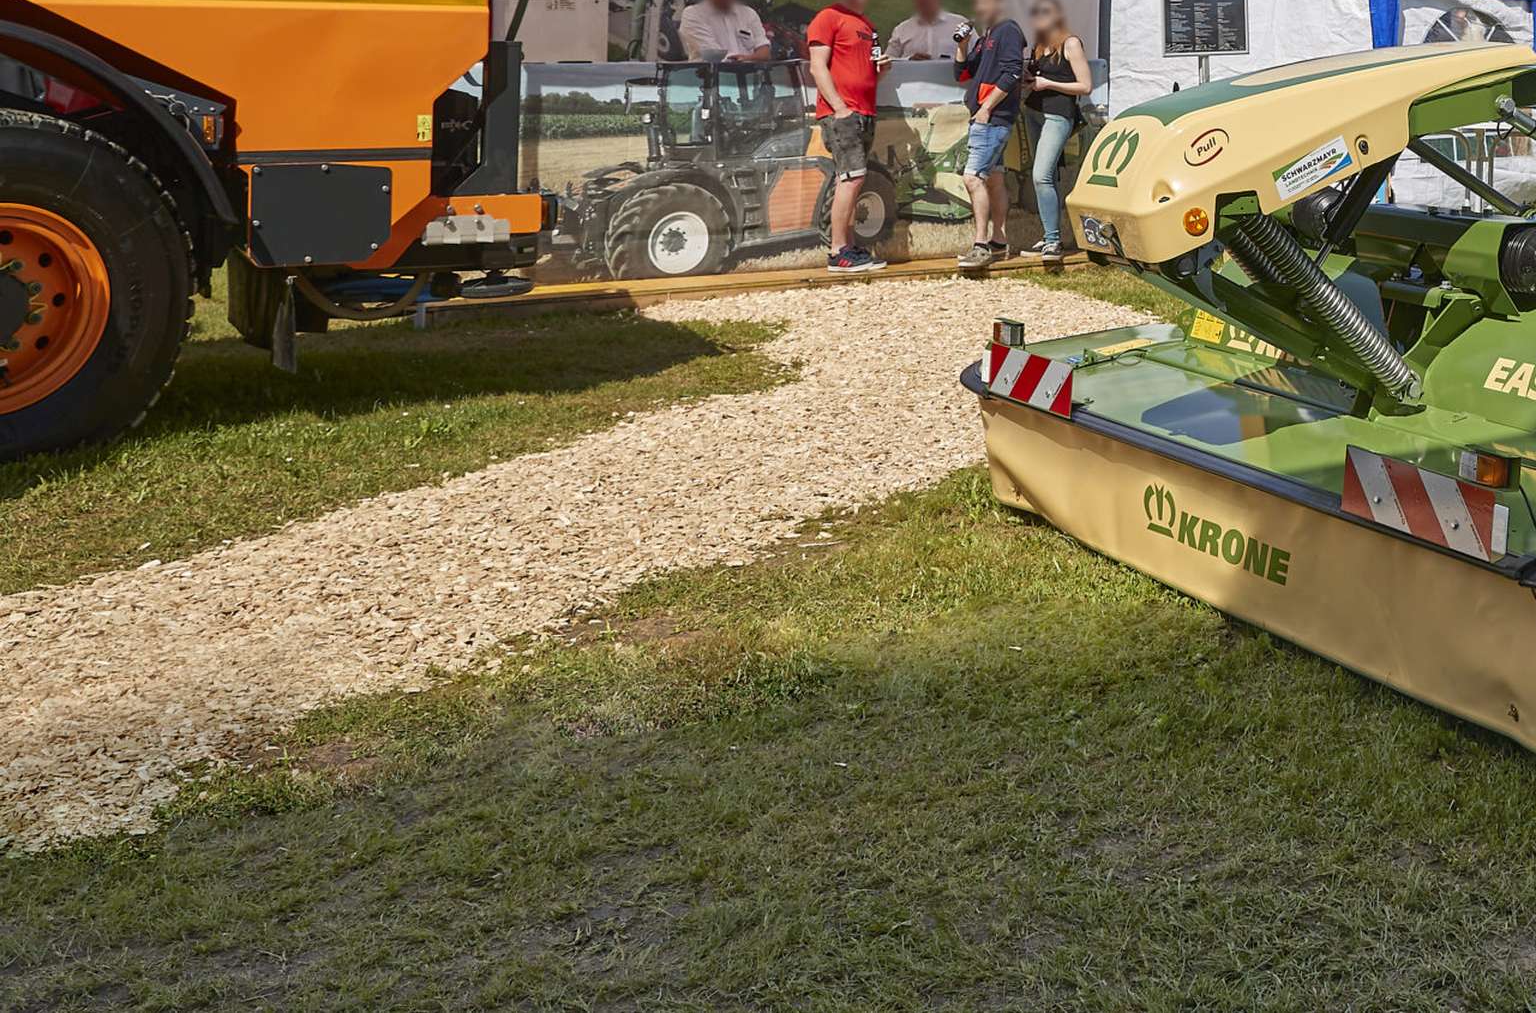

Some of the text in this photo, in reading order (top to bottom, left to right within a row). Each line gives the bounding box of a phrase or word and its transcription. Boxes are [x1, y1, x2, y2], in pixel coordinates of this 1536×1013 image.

[1196, 136, 1217, 157] Pull
[1280, 147, 1338, 183] SCHWARZMAYR
[1177, 510, 1291, 587] KRONE
